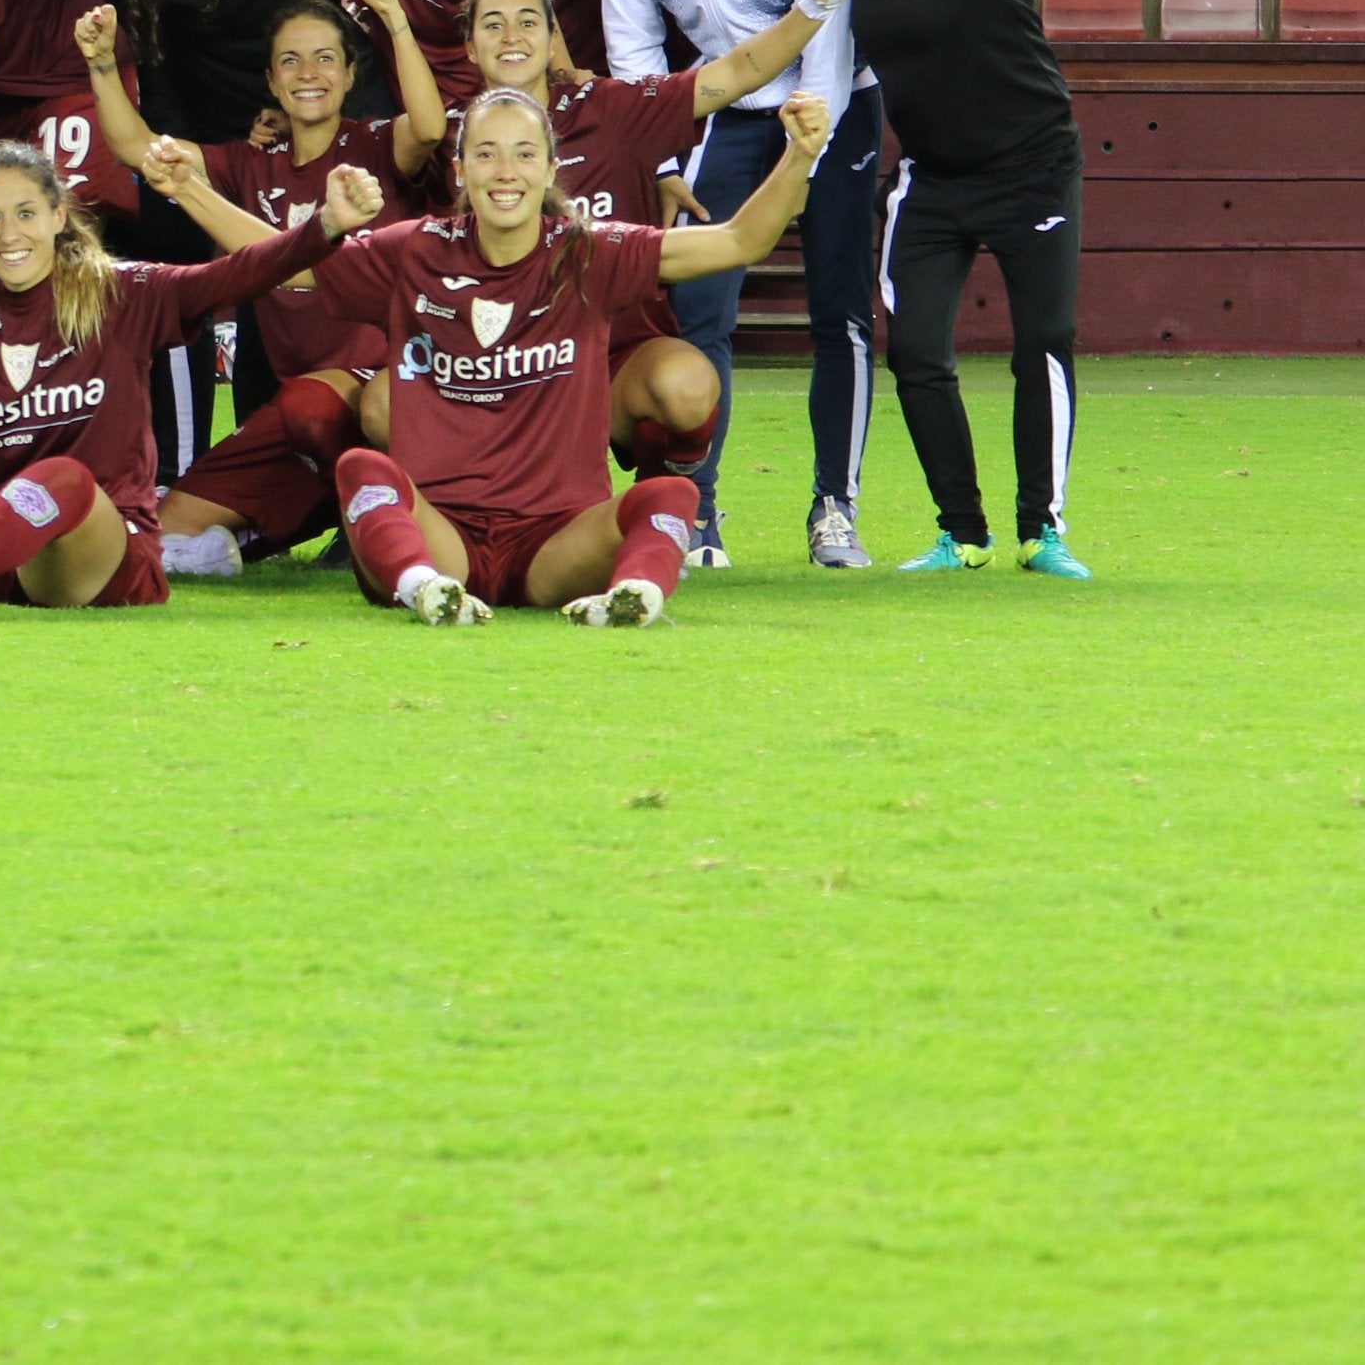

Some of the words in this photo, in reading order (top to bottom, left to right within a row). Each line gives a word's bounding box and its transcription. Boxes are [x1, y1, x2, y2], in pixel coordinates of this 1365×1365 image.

[38, 115, 91, 168] 19
[433, 338, 575, 384] gesitma
[472, 392, 504, 404] GROUP
[4, 433, 34, 447] GROUP
